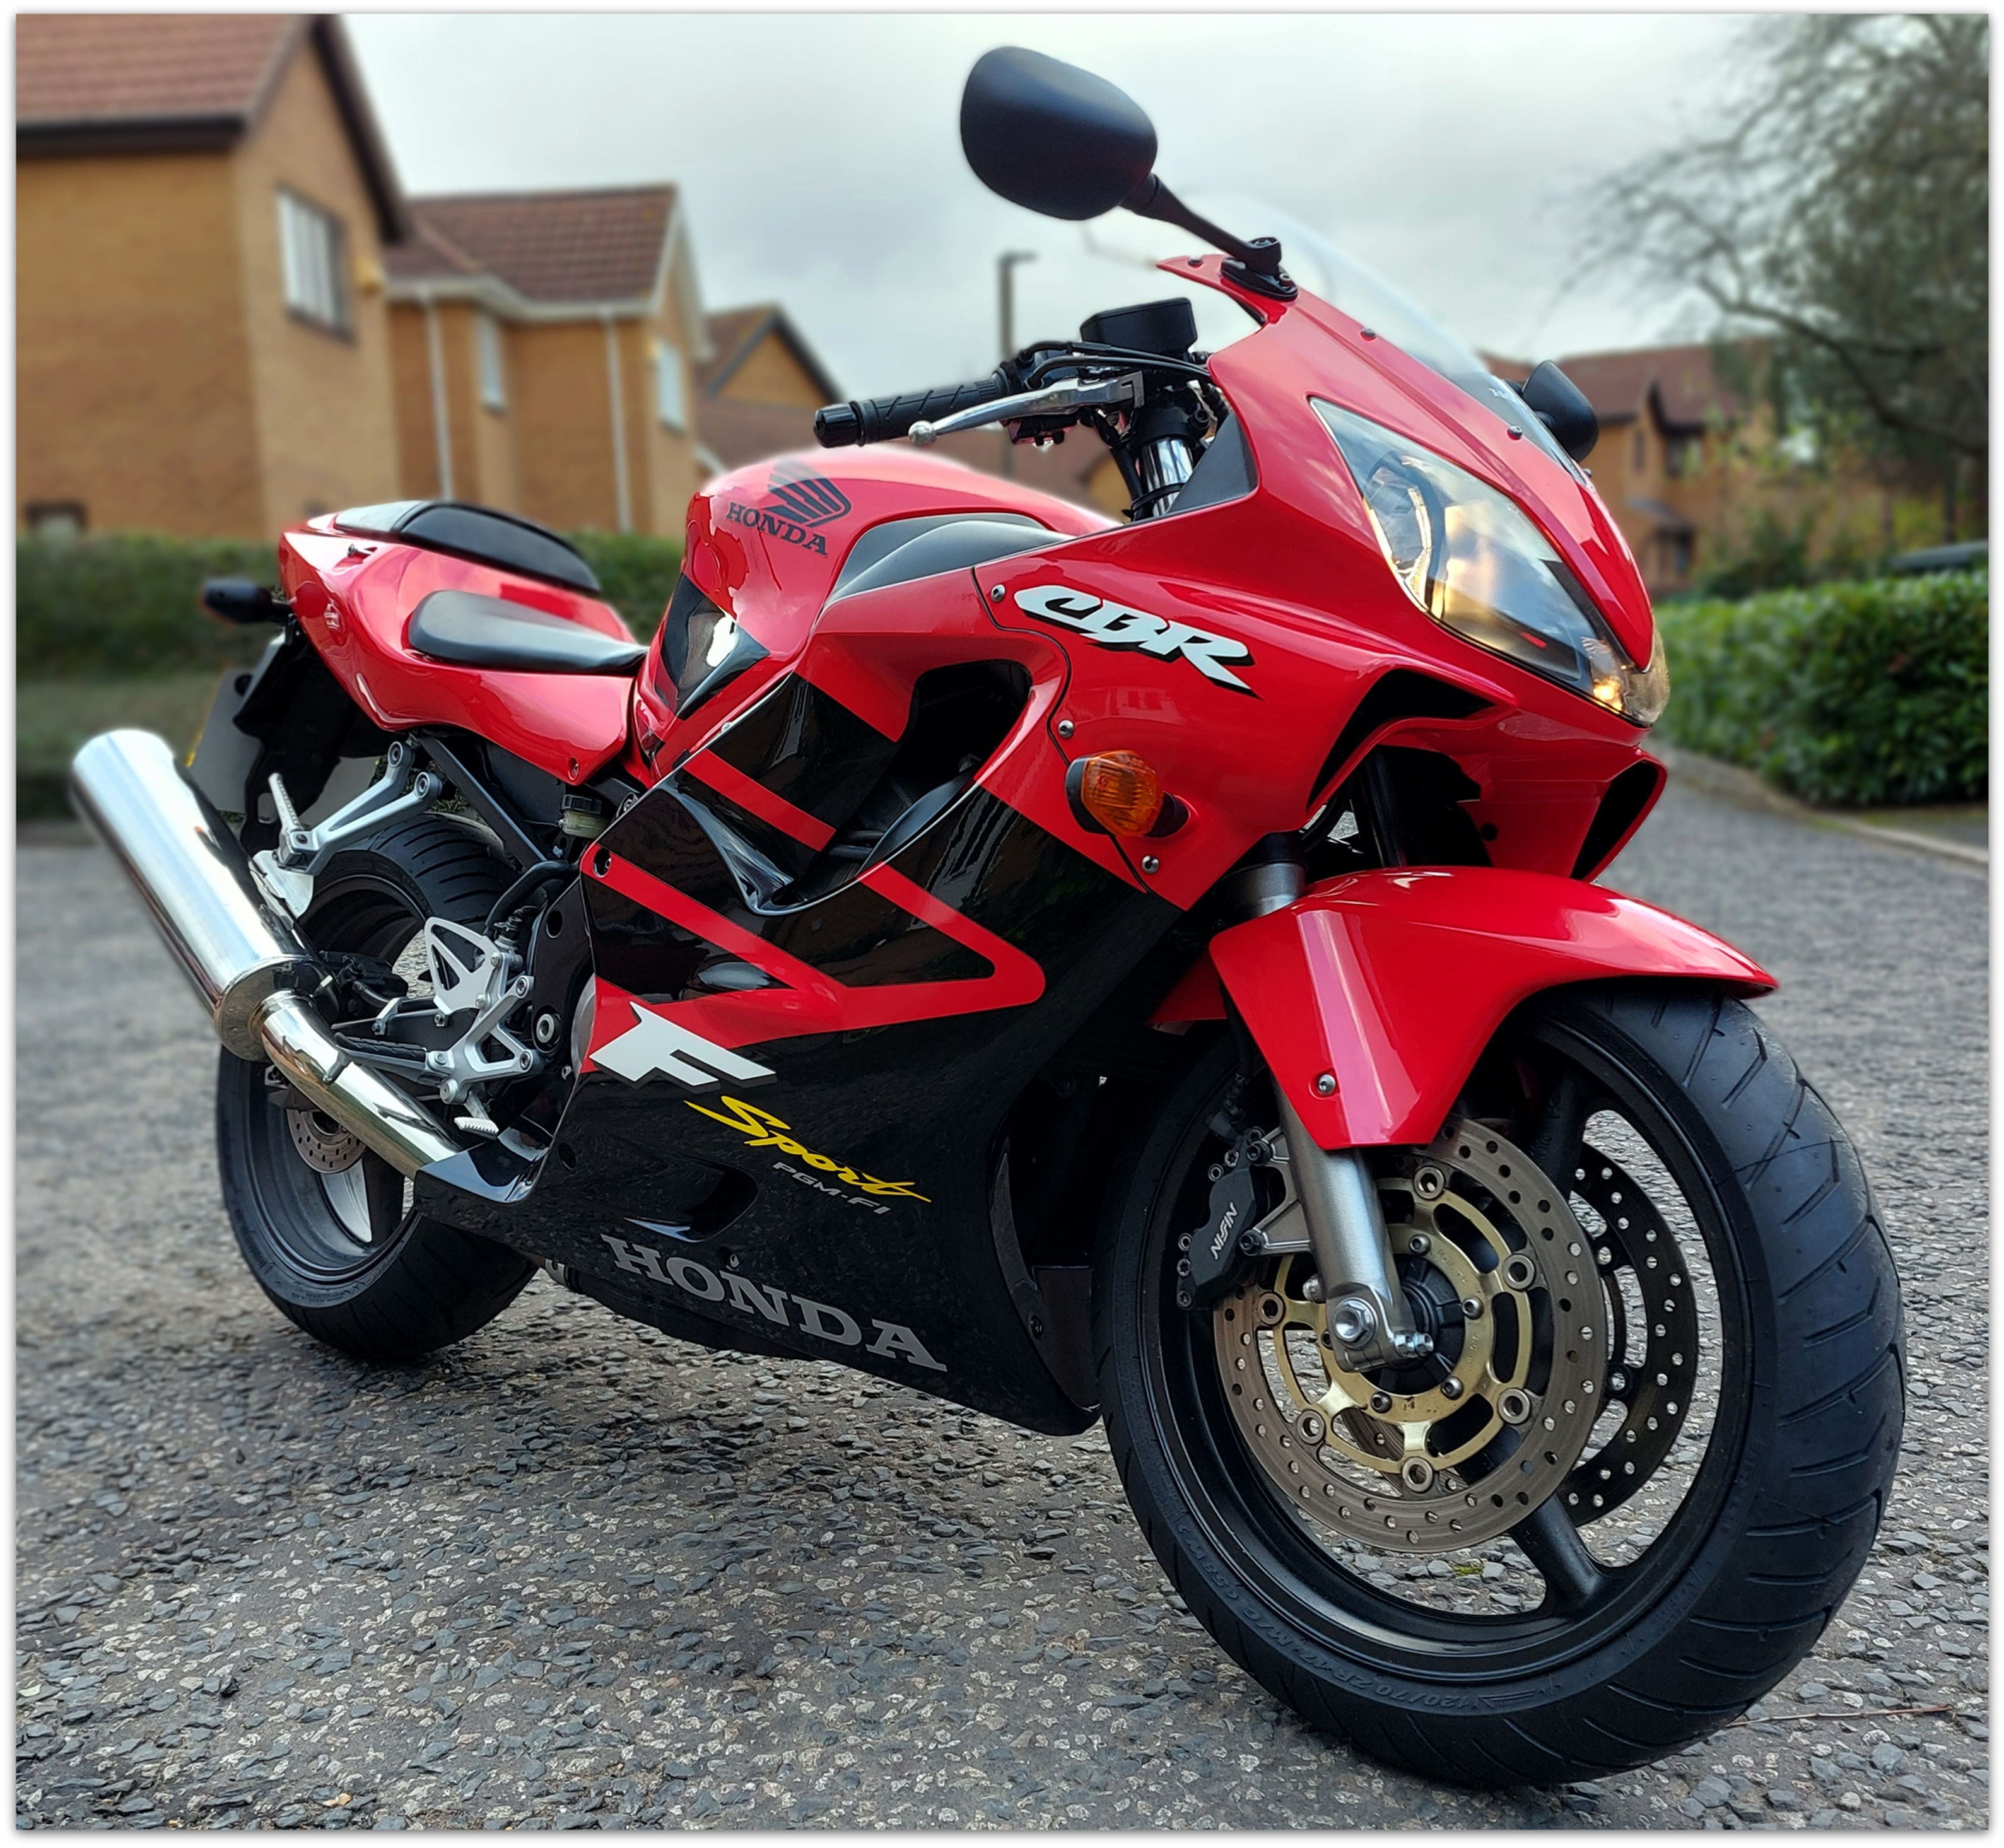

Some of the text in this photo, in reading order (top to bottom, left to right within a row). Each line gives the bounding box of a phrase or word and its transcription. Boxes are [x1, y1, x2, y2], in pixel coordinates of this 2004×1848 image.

[726, 501, 828, 557] HONDA
[1014, 585, 1263, 701] CBR
[589, 1001, 778, 1094] F
[683, 1095, 932, 1203] Sport
[772, 1161, 891, 1215] PGM-FI
[601, 1234, 947, 1372] HONDA
[1374, 1682, 1469, 1709] 120/70
